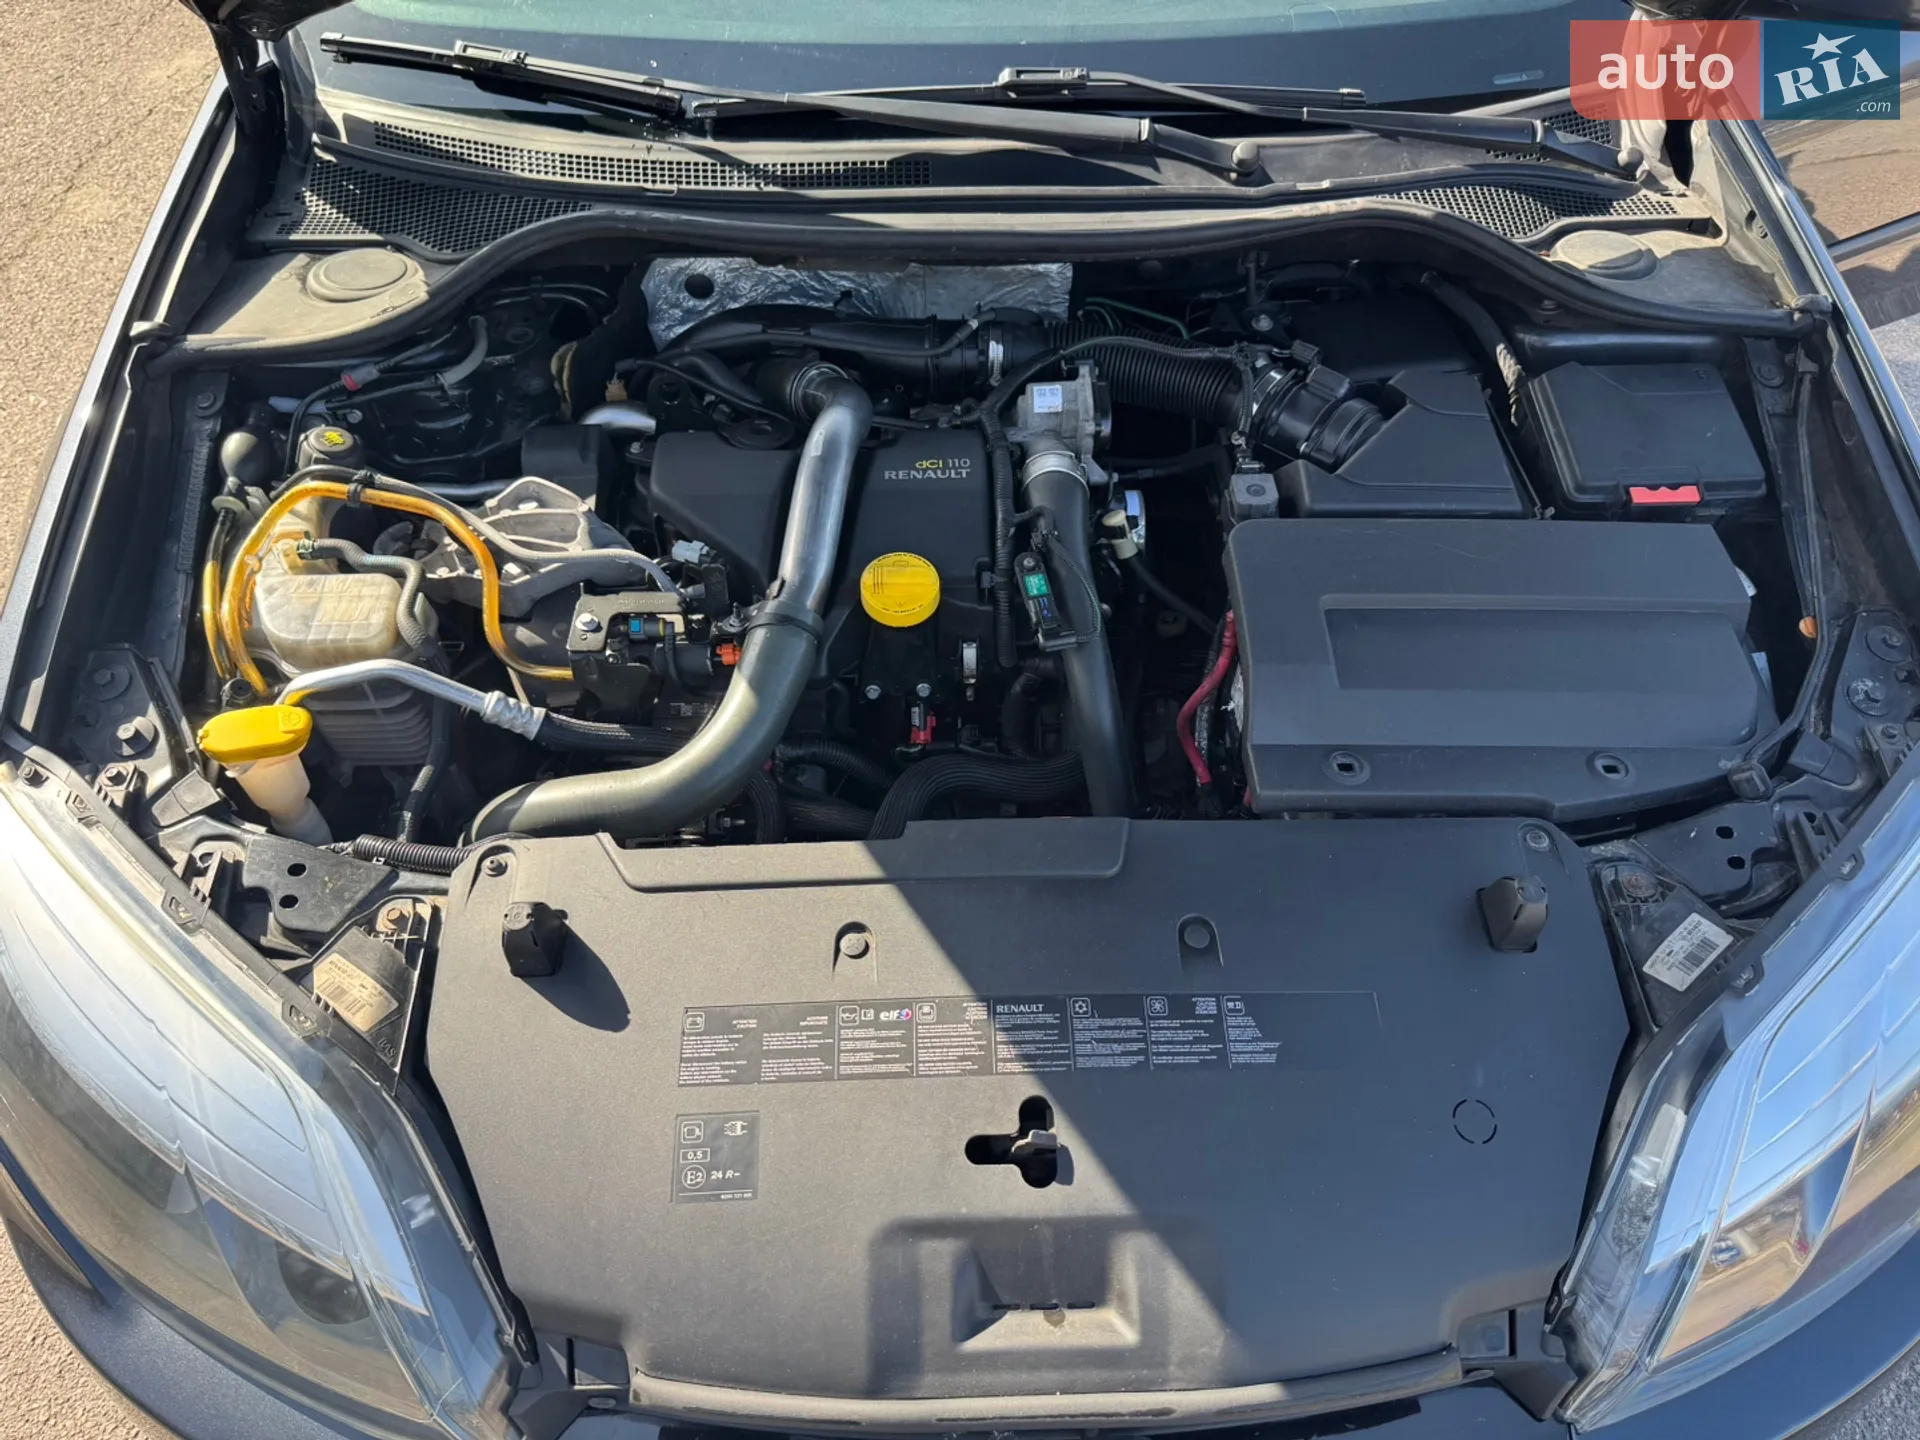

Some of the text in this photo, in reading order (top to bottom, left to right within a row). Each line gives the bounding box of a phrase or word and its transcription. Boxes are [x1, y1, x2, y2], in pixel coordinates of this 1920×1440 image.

[948, 458, 971, 468] 110
[884, 469, 971, 480] RENAULT
[995, 1004, 1045, 1013] RENAULT
[879, 1009, 901, 1021] elf
[687, 1150, 703, 1161] 0,5
[686, 1170, 703, 1184] E2
[710, 1170, 723, 1180] 24
